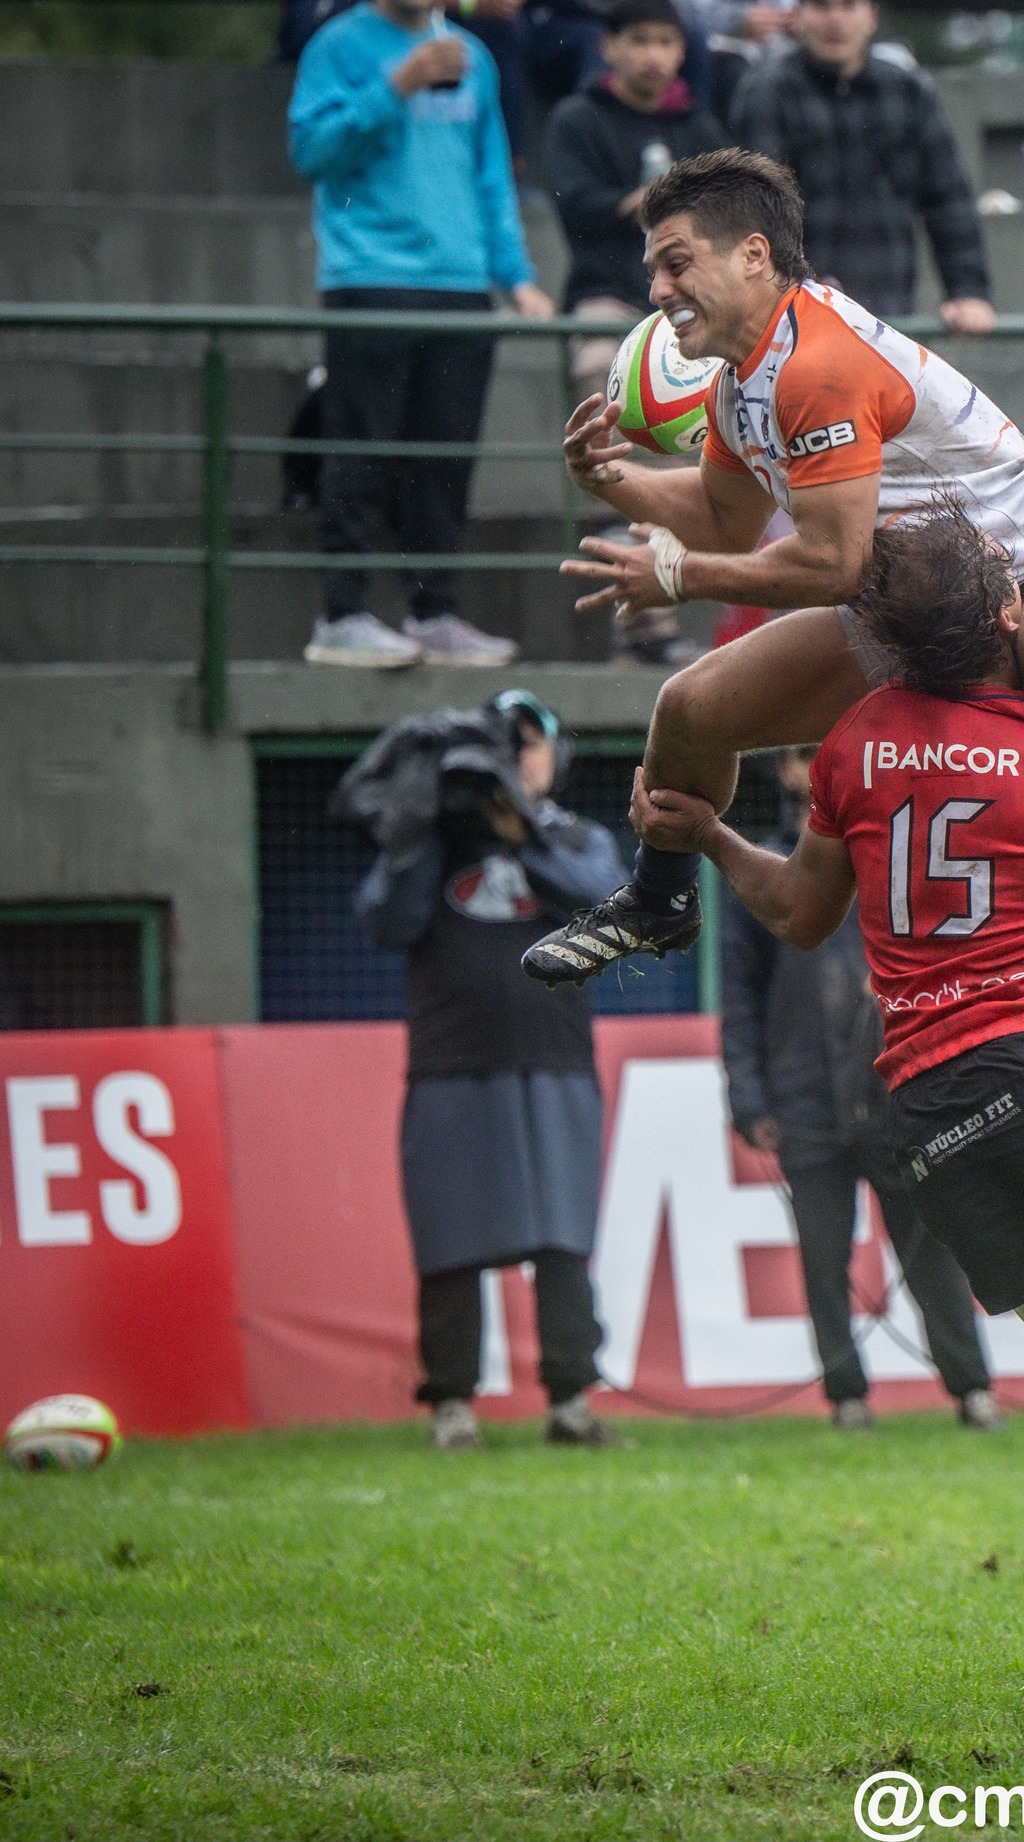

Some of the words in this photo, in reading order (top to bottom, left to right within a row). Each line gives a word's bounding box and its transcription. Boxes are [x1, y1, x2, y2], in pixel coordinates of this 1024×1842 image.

[789, 421, 856, 457] JCB
[877, 741, 1020, 777] BANCOR
[888, 794, 996, 939] 15
[925, 1113, 985, 1158] NÚCLEO
[984, 1092, 1014, 1121] FIT
[984, 1106, 1022, 1134] SUPPLEMENTS
